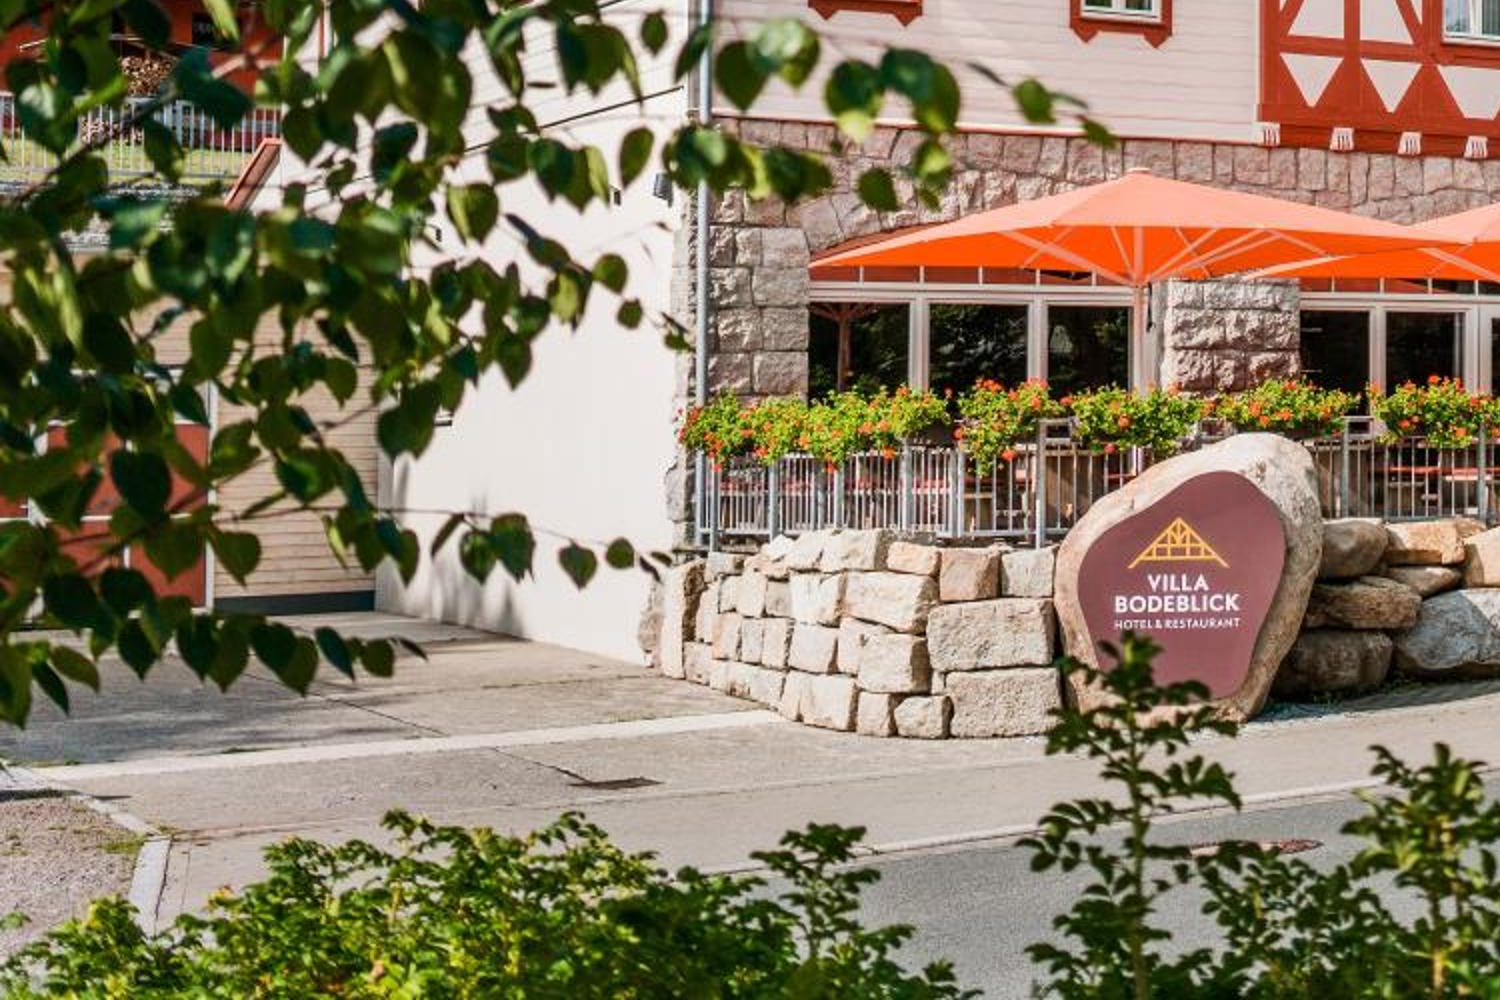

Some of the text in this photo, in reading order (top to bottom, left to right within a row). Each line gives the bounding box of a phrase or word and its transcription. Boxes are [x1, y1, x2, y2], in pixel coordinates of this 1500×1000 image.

[1147, 573, 1209, 592] VILLA
[1115, 593, 1240, 613] BODEBLICK
[1114, 619, 1153, 630] HOTEL
[1164, 617, 1241, 629] RESTAURANT
